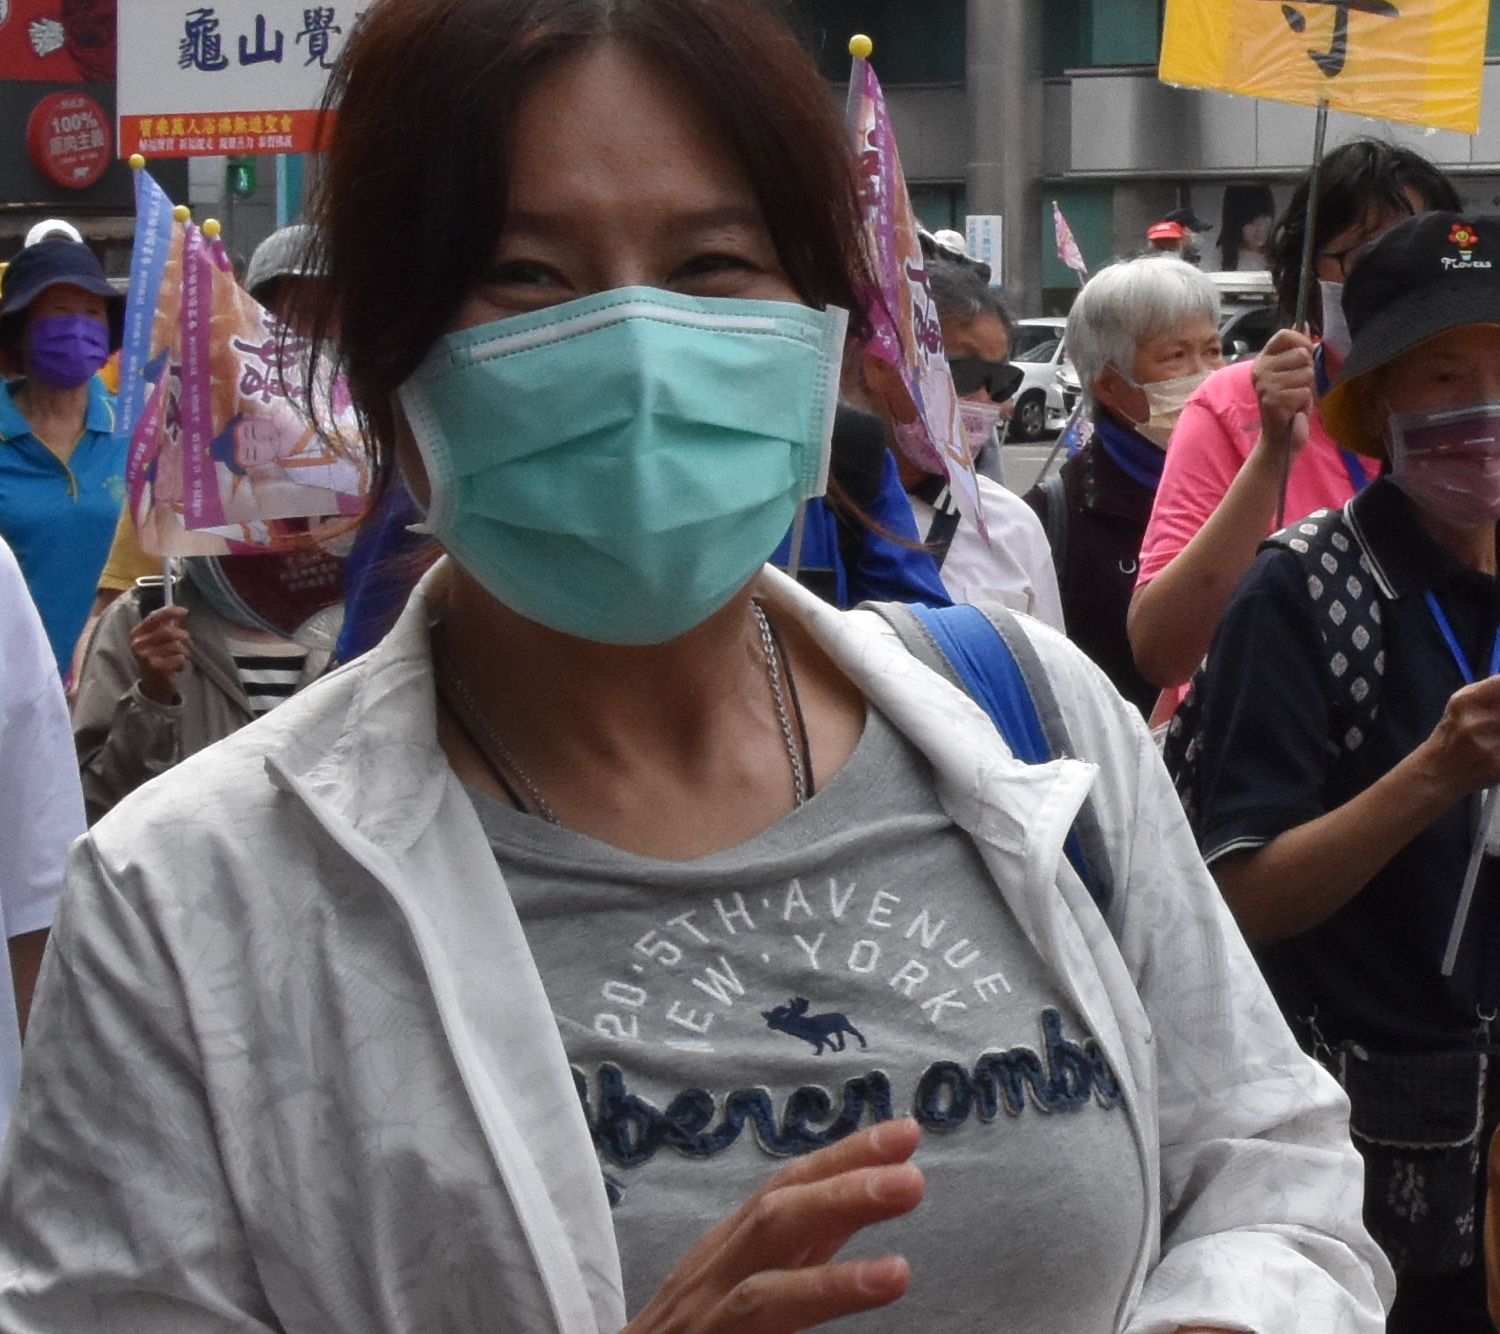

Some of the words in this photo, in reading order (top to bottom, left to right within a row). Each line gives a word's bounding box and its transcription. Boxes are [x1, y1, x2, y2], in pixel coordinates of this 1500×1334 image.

[177, 5, 366, 73] 龜山覺
[52, 111, 99, 134] 100%
[783, 877, 1013, 1003] AVENUE
[664, 955, 746, 1053] EW
[793, 931, 968, 1025] YORK
